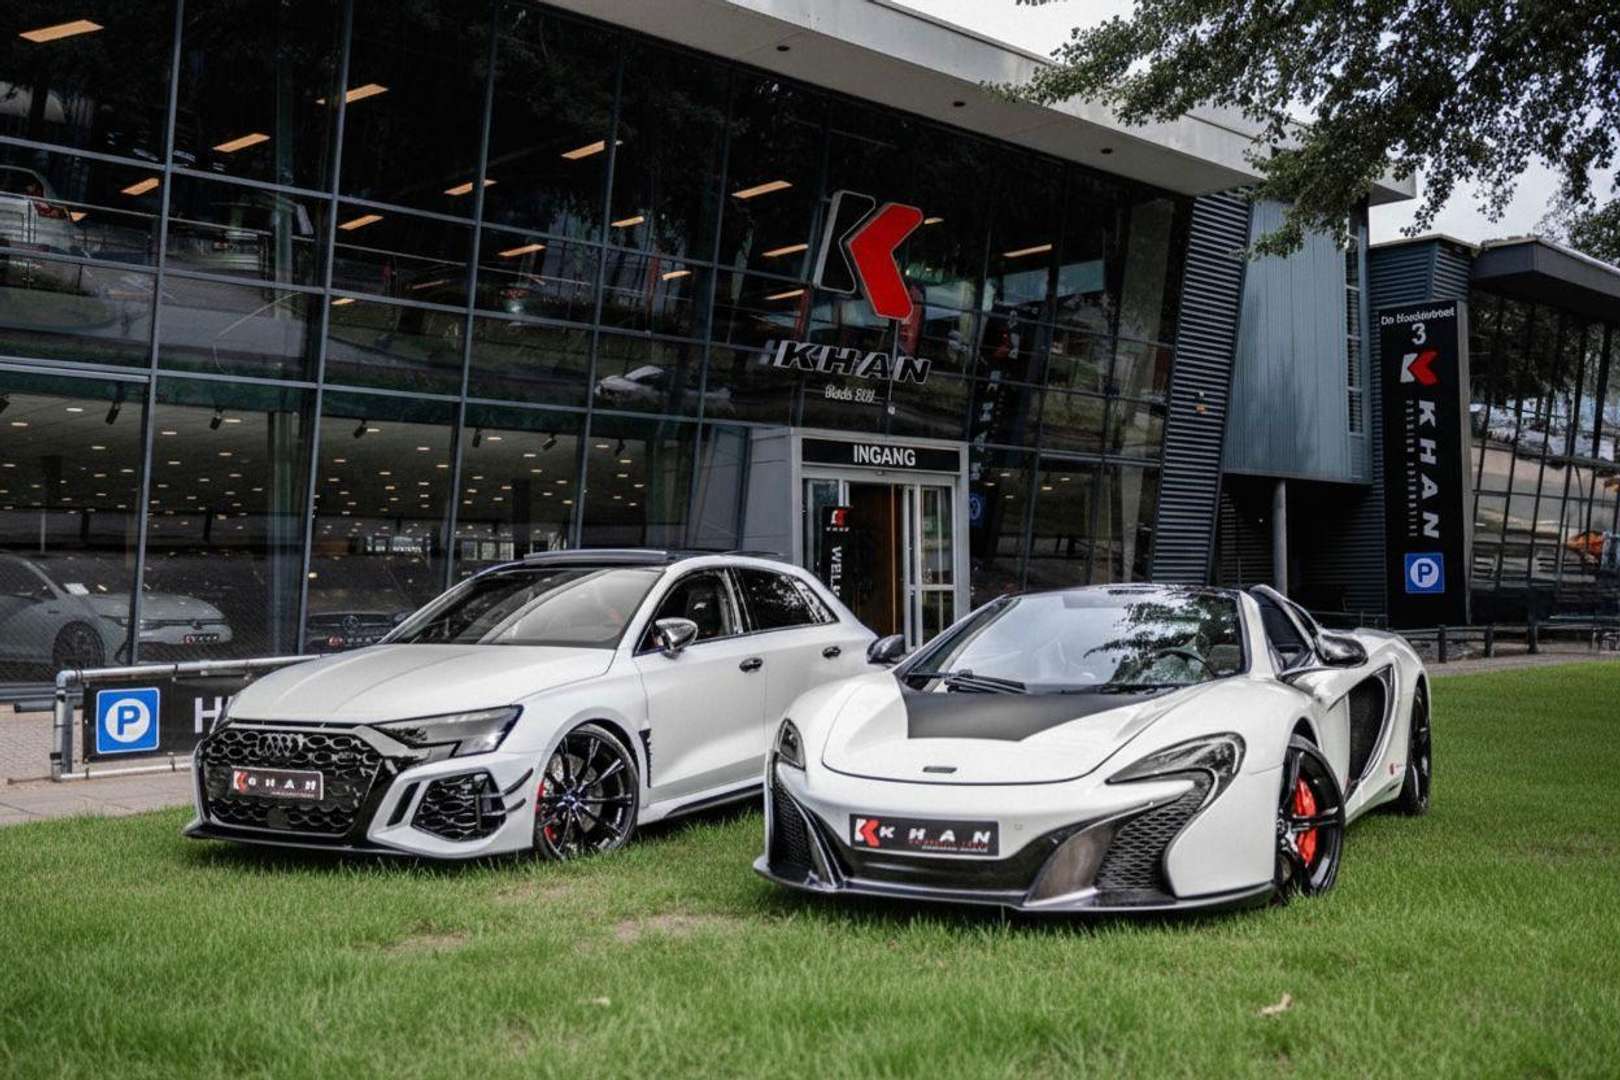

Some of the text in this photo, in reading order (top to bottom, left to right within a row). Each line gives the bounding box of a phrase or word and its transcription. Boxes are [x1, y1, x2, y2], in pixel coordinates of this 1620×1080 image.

[1412, 323, 1427, 346] 3
[773, 340, 932, 384] KHAN
[852, 445, 916, 466] INGANG
[1418, 400, 1440, 539] KHAN
[879, 826, 991, 844] KHAN
